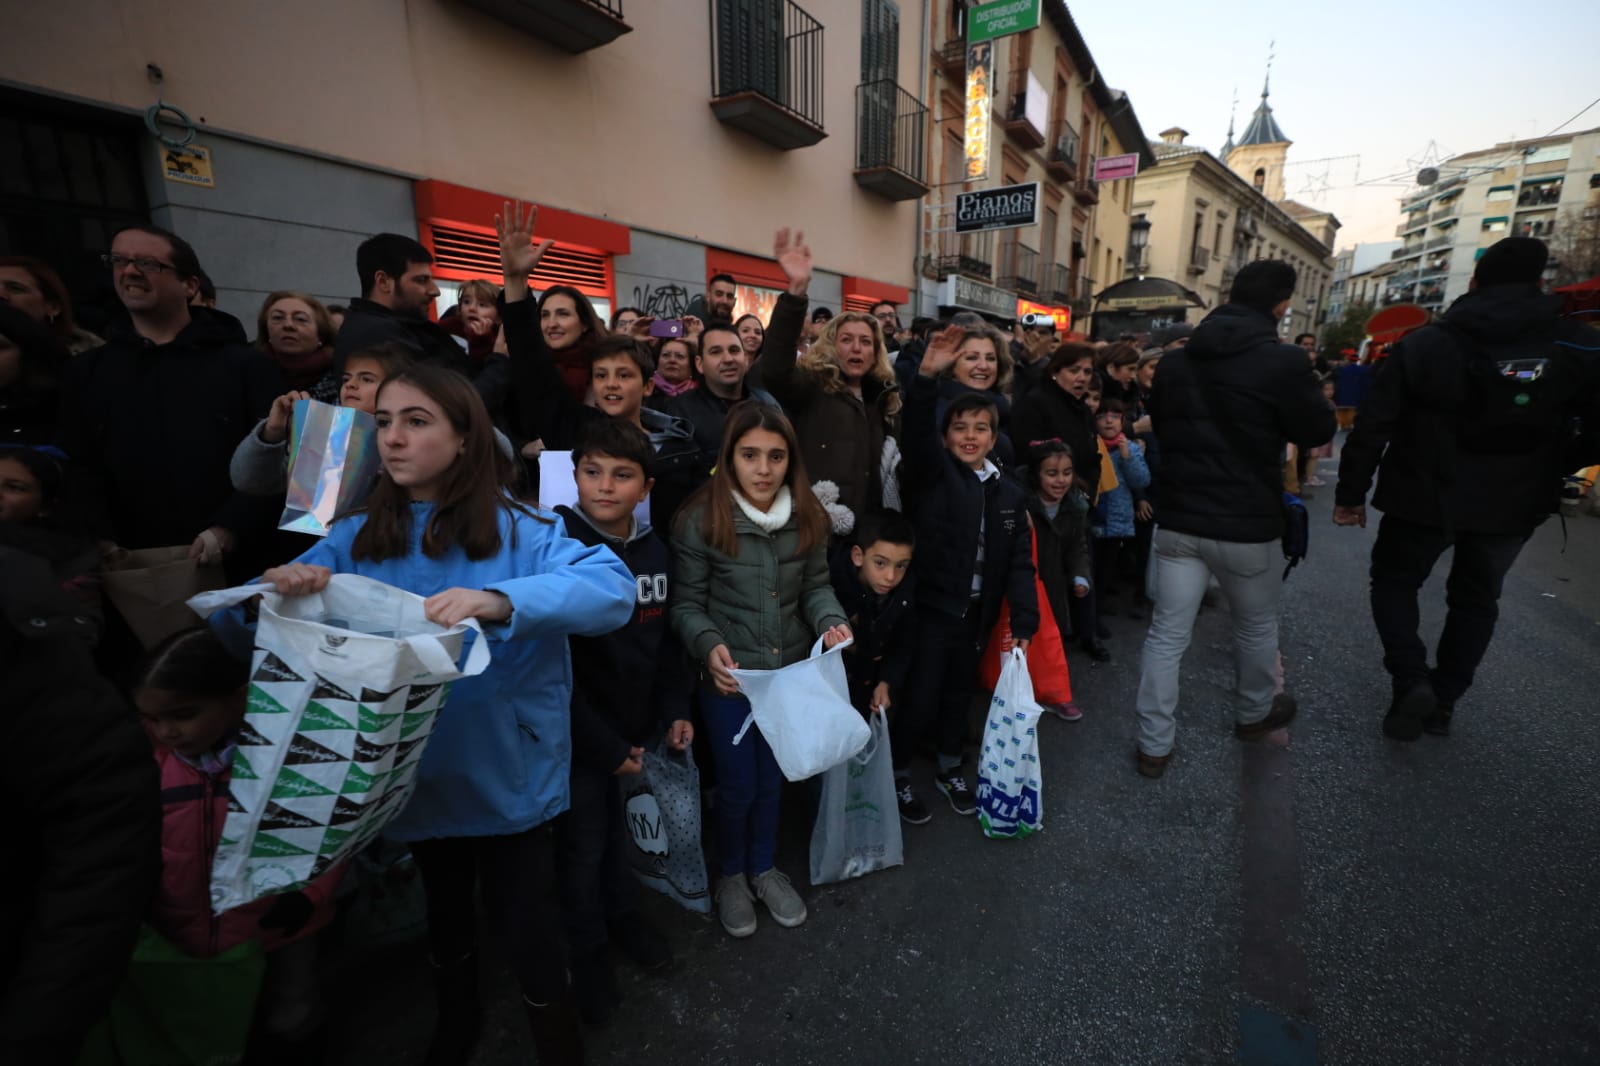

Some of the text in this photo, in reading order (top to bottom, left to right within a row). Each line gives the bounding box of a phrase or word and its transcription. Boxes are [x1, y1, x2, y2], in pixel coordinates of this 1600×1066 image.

[976, 0, 1031, 23] DISTRIBUIDOR
[987, 15, 1018, 32] OFICIAL
[967, 44, 988, 176] TABACOS
[959, 202, 1032, 221] Granada
[960, 190, 1034, 212] Pianos
[635, 574, 668, 603] CO
